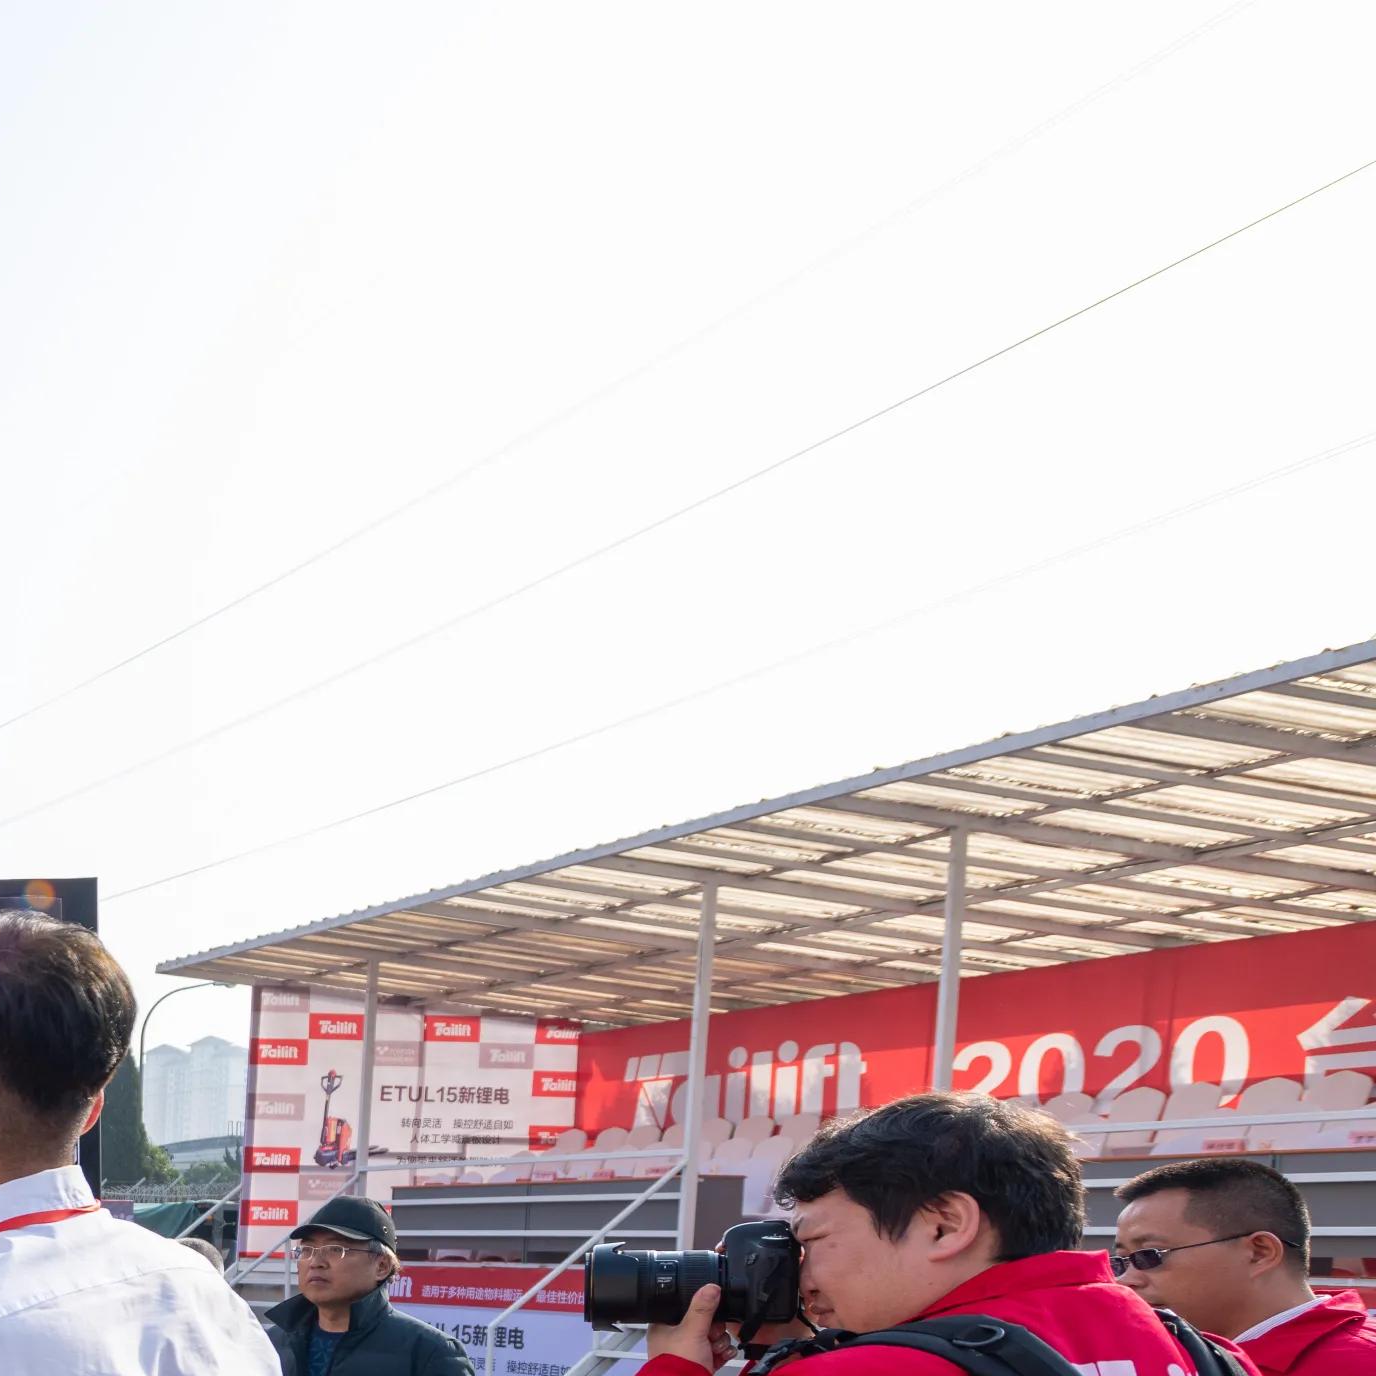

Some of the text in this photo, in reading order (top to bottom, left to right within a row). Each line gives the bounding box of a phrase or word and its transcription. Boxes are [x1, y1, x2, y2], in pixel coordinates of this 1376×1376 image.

[319, 1020, 357, 1035] Tailift
[434, 1022, 471, 1037] Tailift
[259, 1044, 298, 1059] Tailift
[624, 1015, 1249, 1128] Tailift 2020
[380, 1085, 510, 1105] ETUL15新锂电
[253, 1152, 291, 1166] Tailift
[251, 1206, 289, 1221] Tailift
